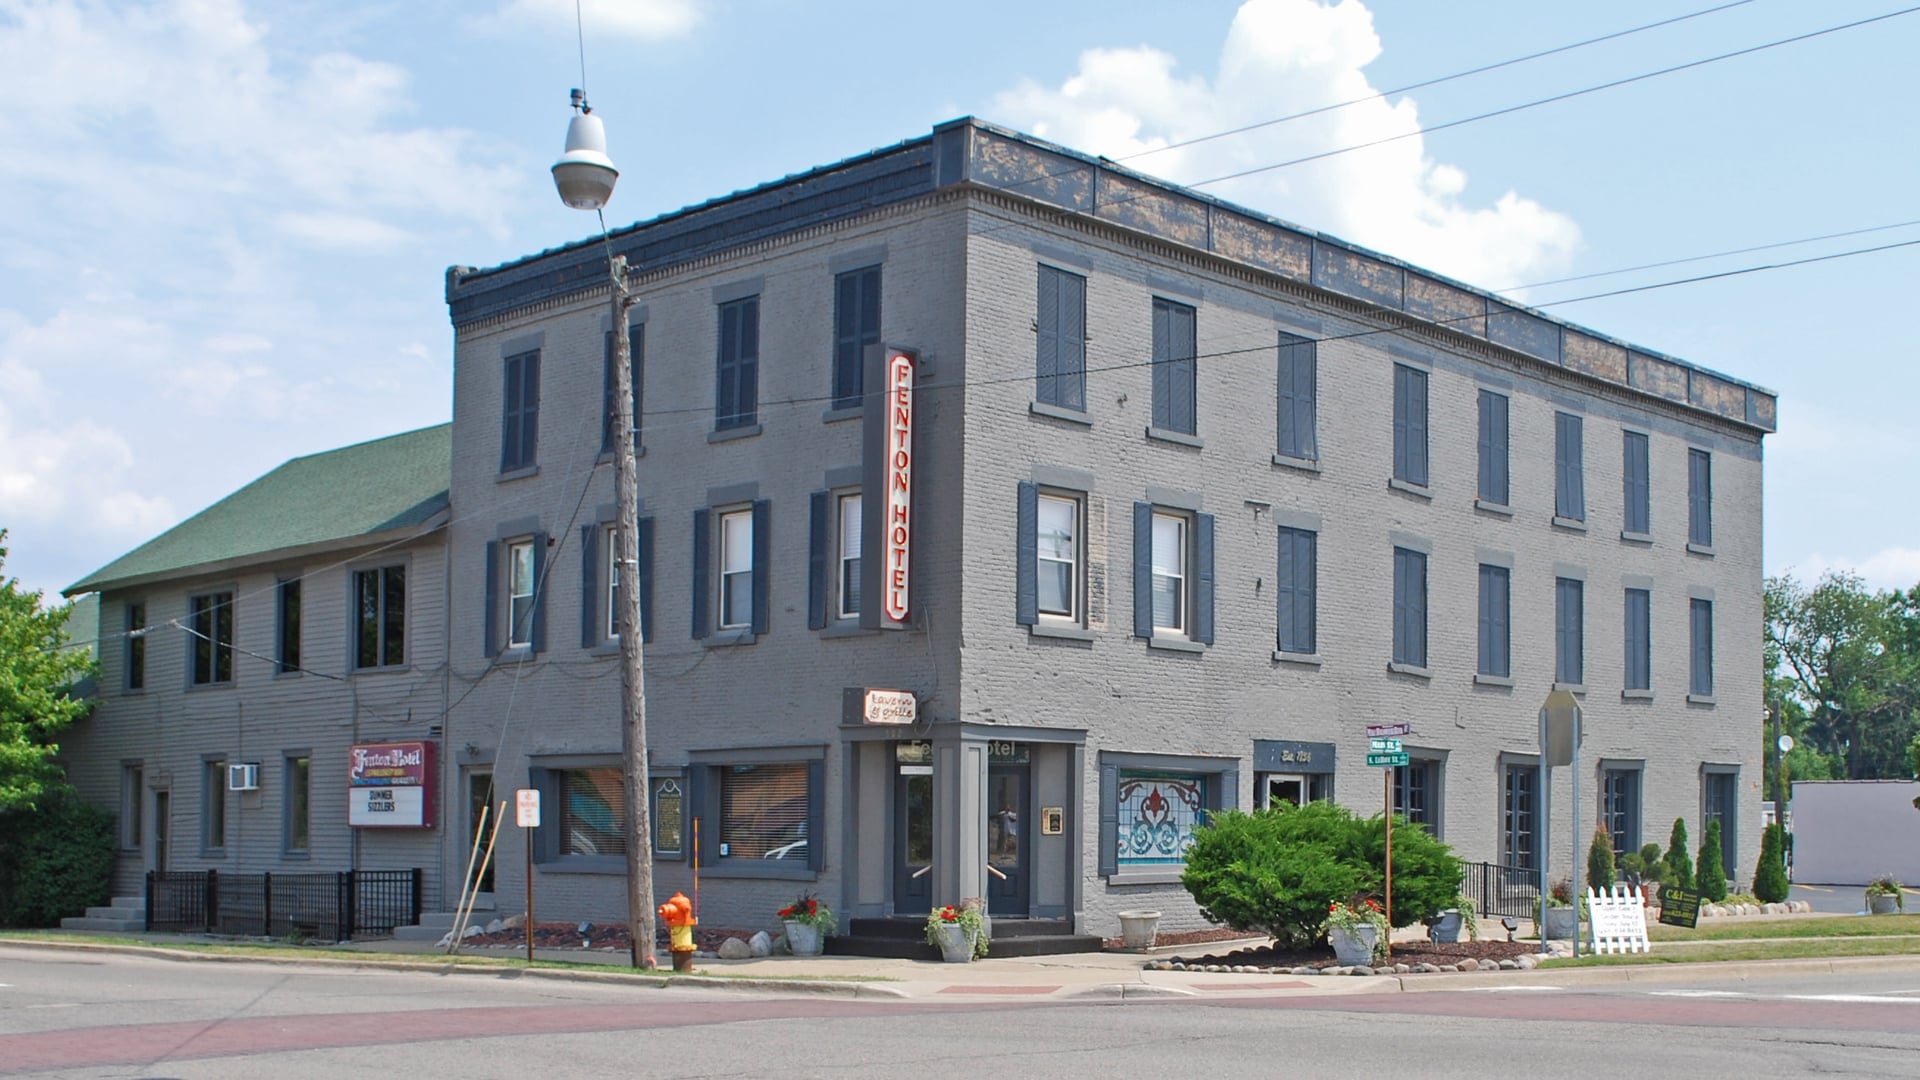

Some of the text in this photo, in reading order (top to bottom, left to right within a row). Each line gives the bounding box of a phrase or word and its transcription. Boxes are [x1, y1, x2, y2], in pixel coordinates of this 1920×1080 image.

[892, 364, 910, 611] FENTON HOTEL
[871, 693, 913, 706] tavern
[988, 740, 1016, 756] otel
[352, 749, 421, 779] Fenton Hotel
[368, 801, 395, 812] SIZZLERS
